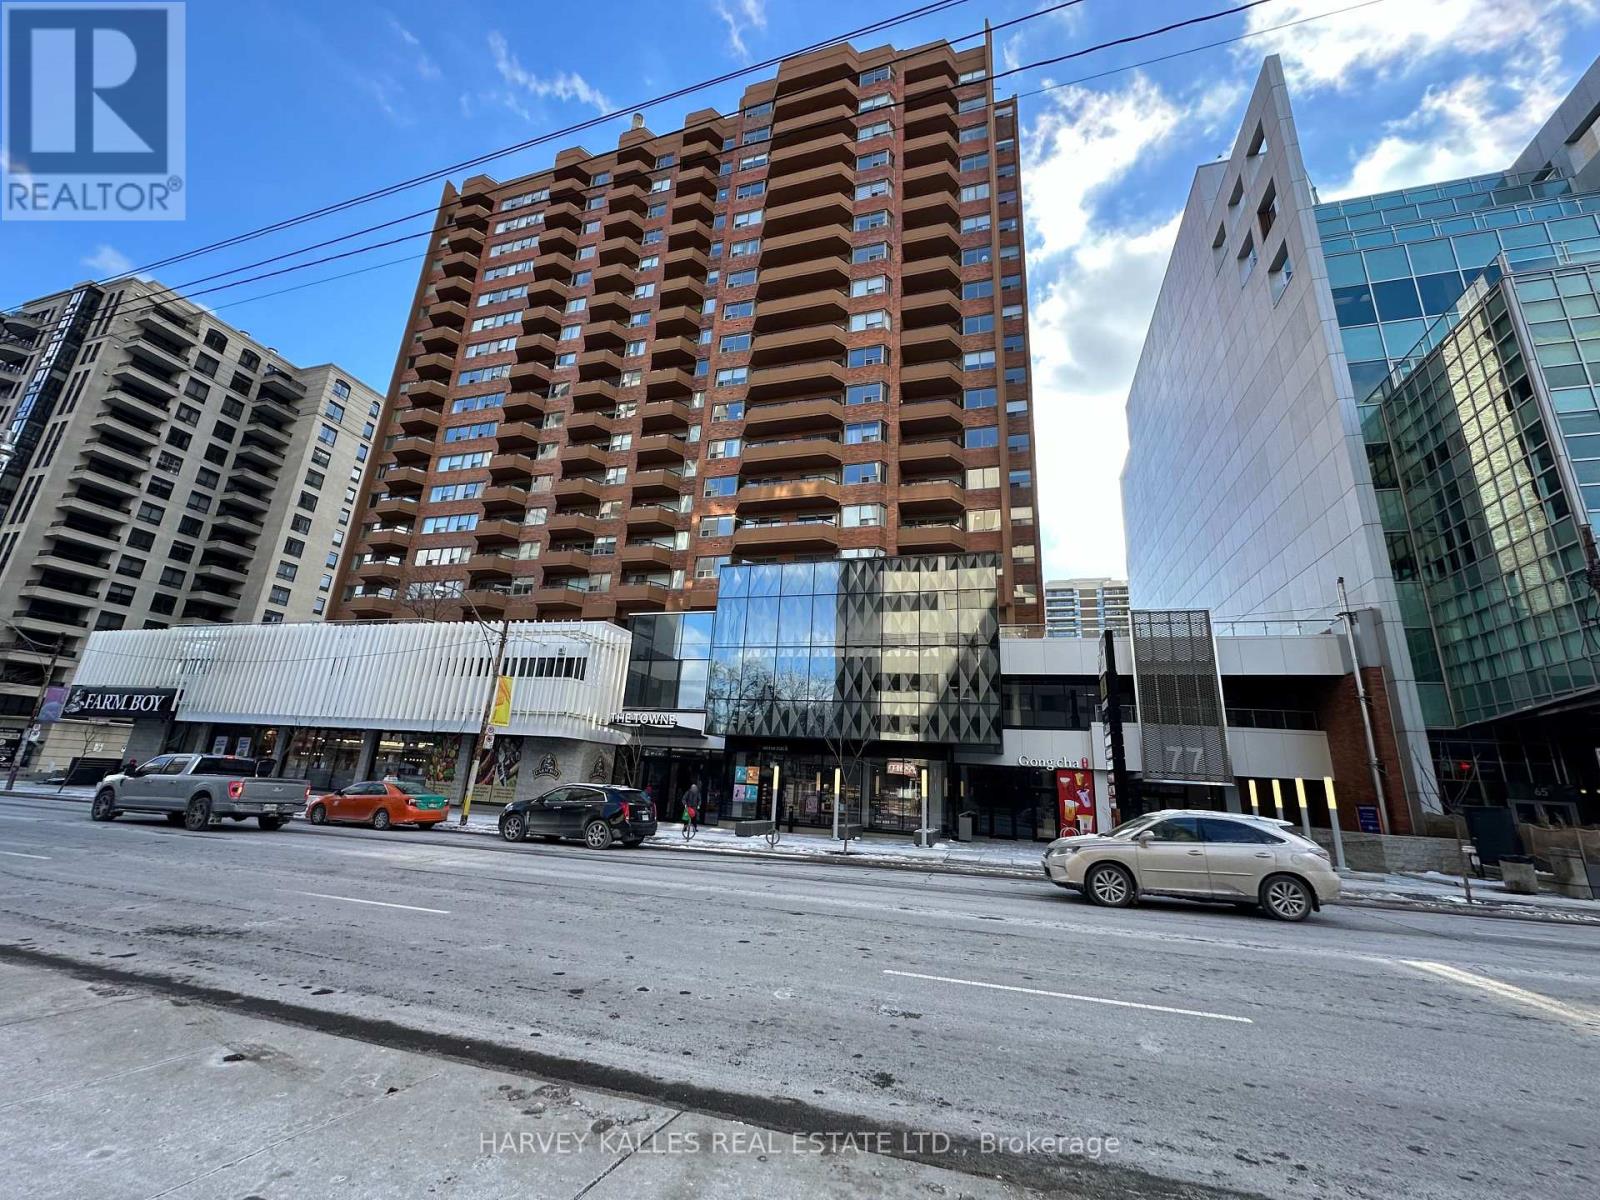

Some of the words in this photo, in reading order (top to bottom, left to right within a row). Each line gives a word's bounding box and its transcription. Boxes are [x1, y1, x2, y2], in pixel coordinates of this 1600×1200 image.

[84, 693, 129, 710] FARM
[128, 694, 166, 712] BOY
[610, 712, 632, 724] THE
[634, 713, 677, 725] TOWNE
[1018, 755, 1055, 771] Gong
[1056, 756, 1079, 768] cha
[1166, 745, 1204, 773] 77
[1534, 787, 1549, 797] 65
